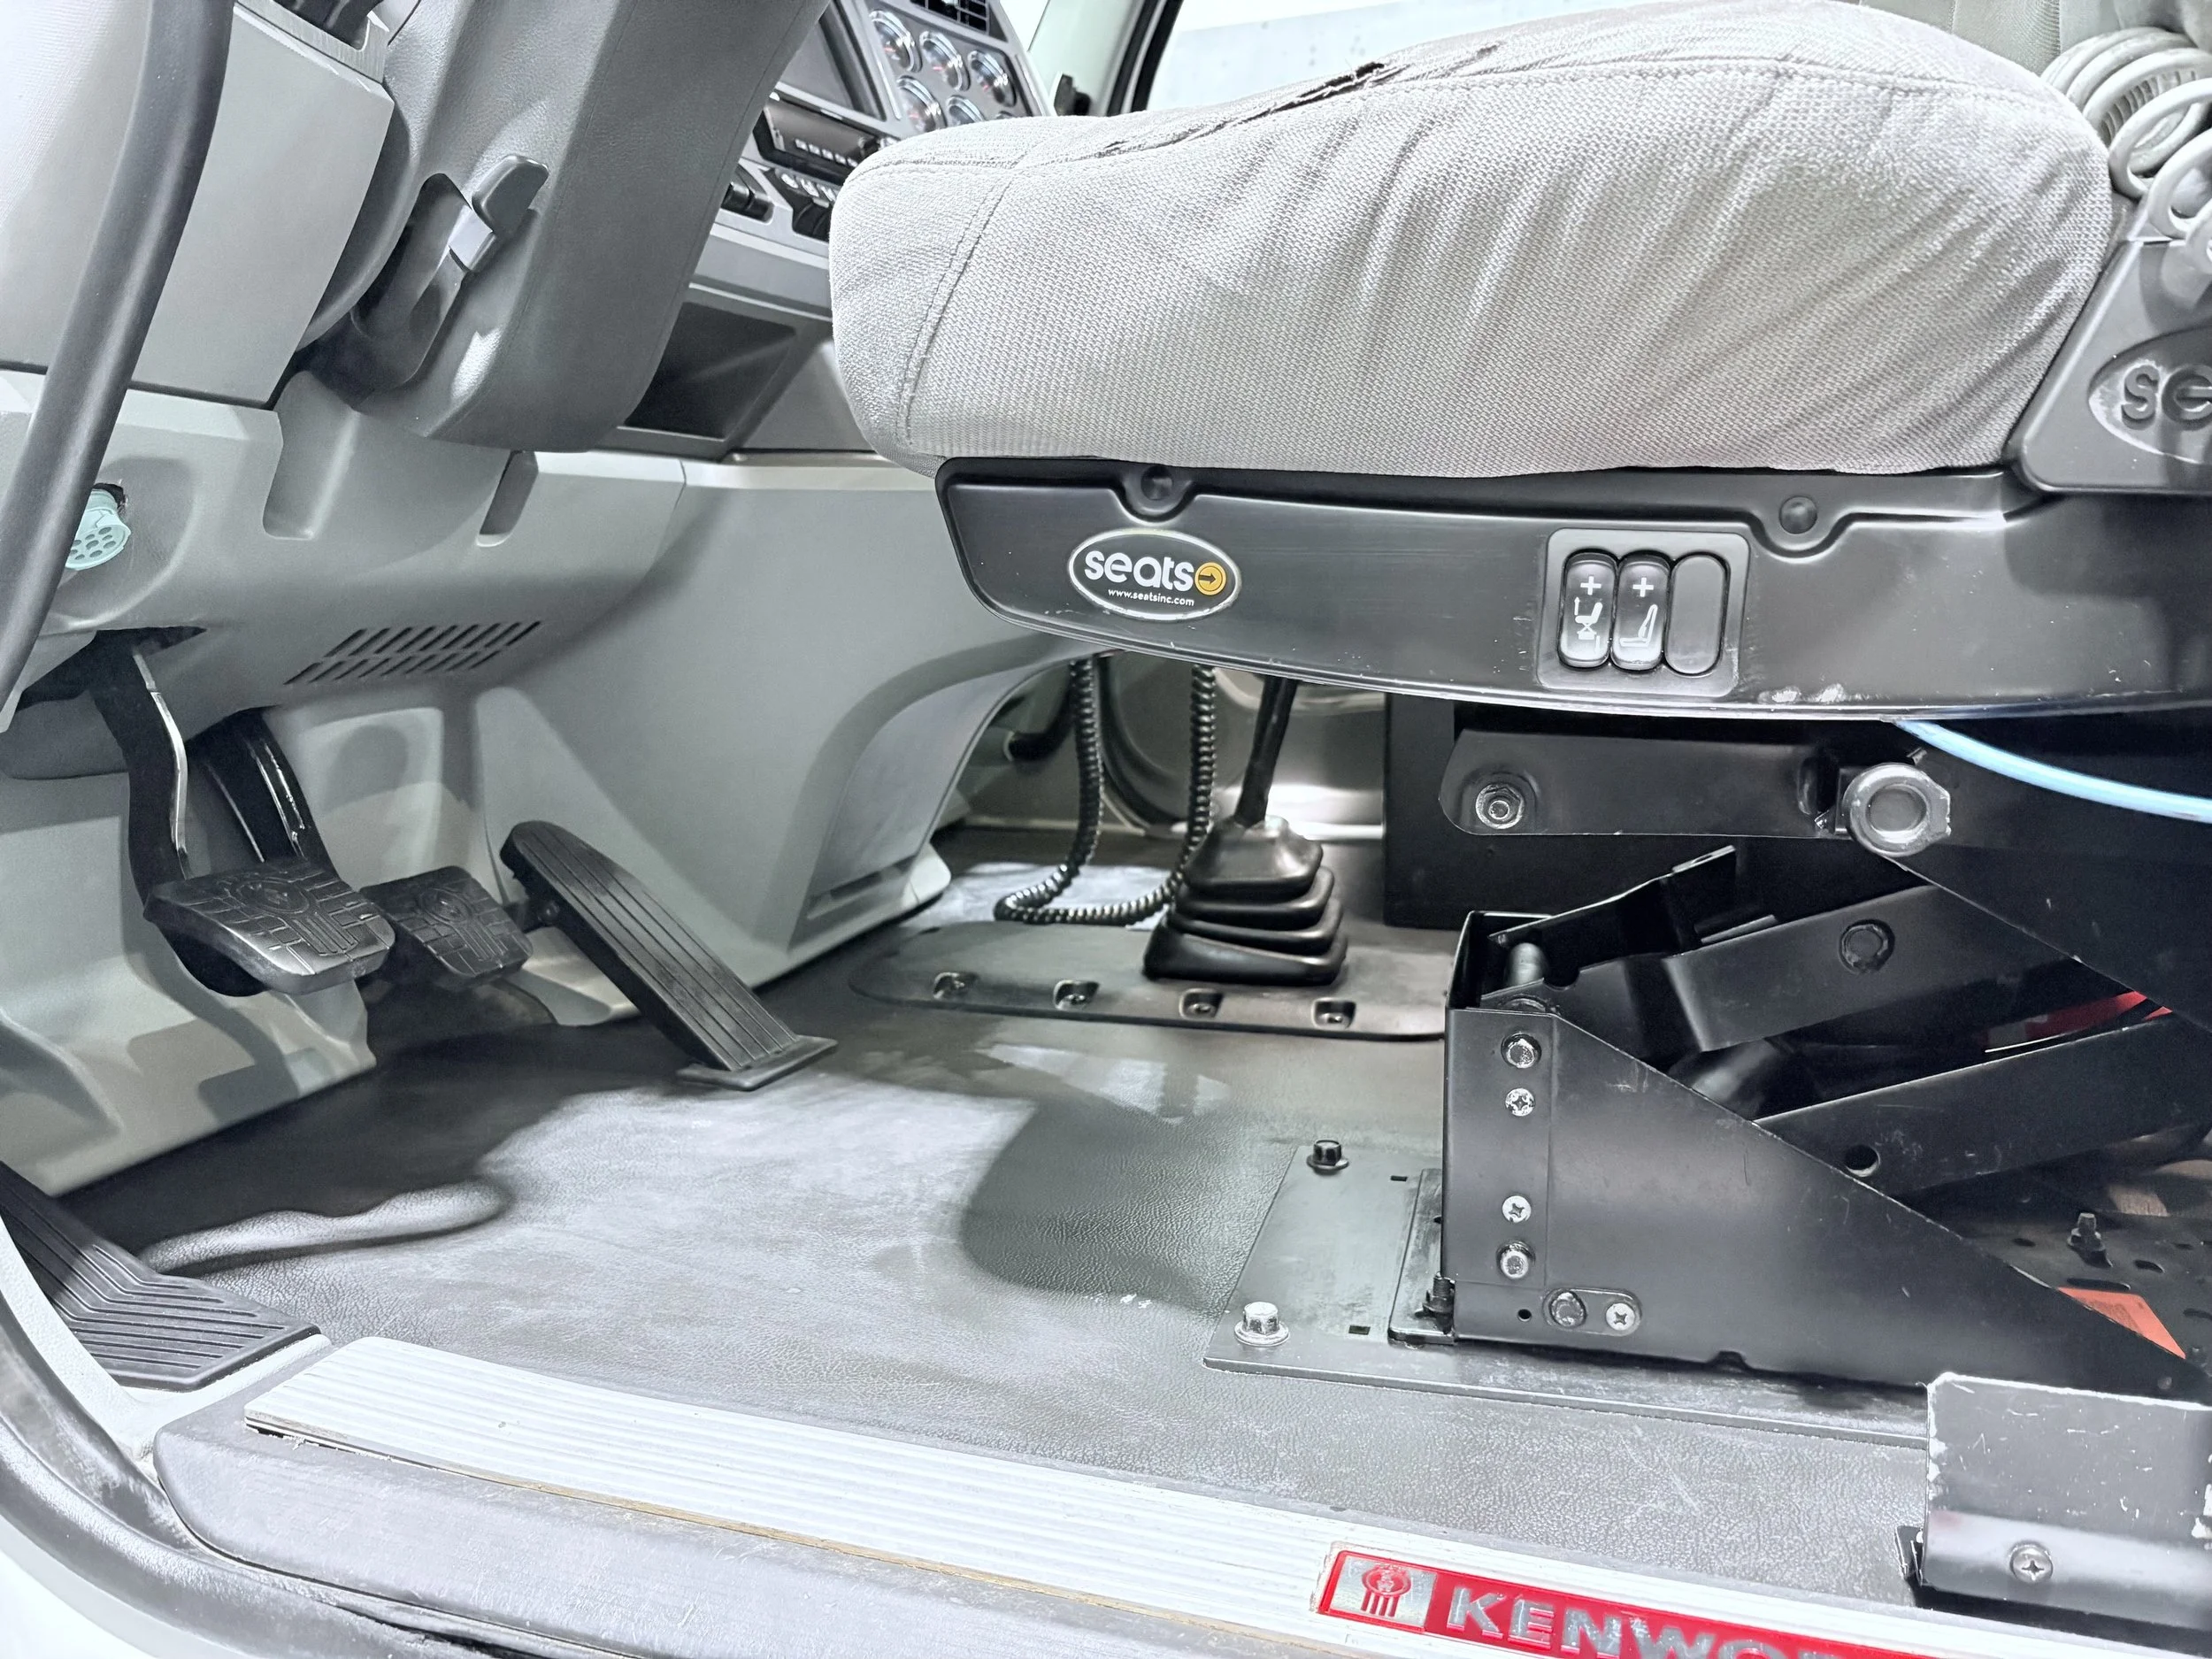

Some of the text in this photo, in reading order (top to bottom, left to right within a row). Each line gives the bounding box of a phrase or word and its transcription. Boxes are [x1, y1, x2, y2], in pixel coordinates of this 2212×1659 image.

[1084, 550, 1194, 592] seats
[1108, 588, 1195, 607] www.seatsinc.com
[1446, 1586, 1839, 1659] KENWO
